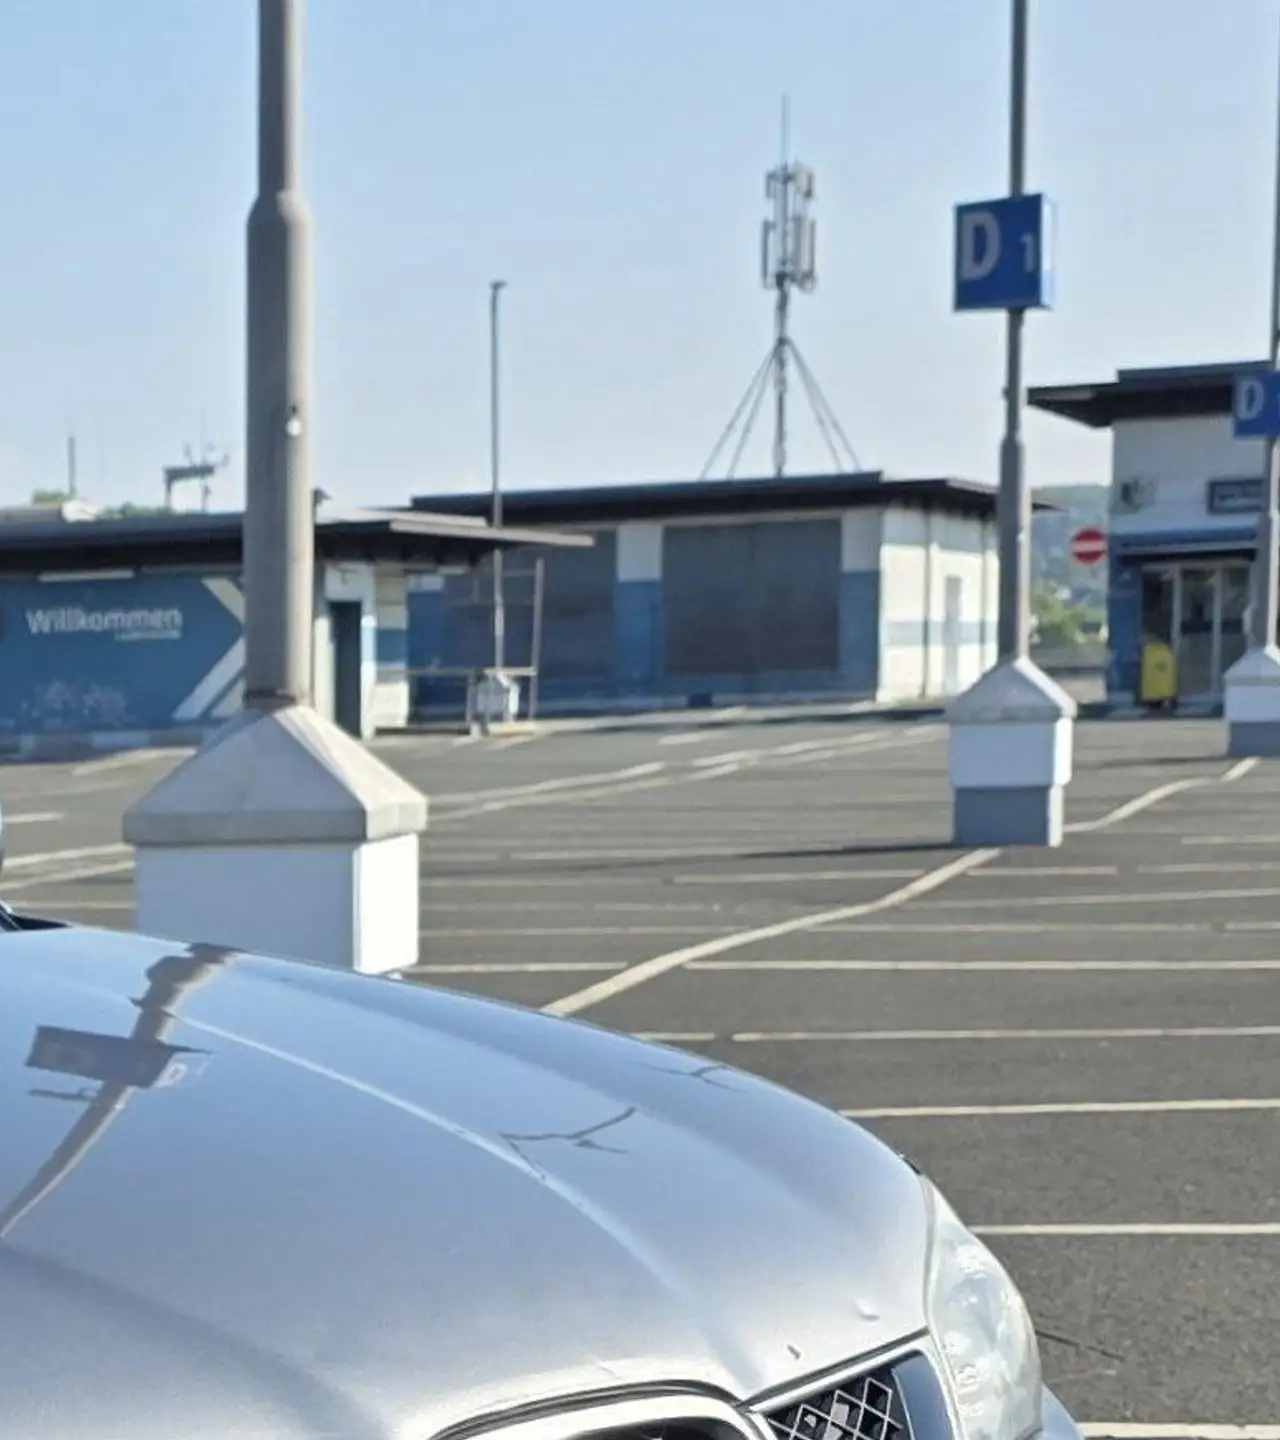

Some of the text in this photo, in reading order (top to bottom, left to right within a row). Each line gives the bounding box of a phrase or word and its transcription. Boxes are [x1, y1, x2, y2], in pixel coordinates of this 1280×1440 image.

[961, 211, 1035, 279] D 1
[1238, 380, 1265, 421] D
[25, 607, 183, 635] Willkommen
